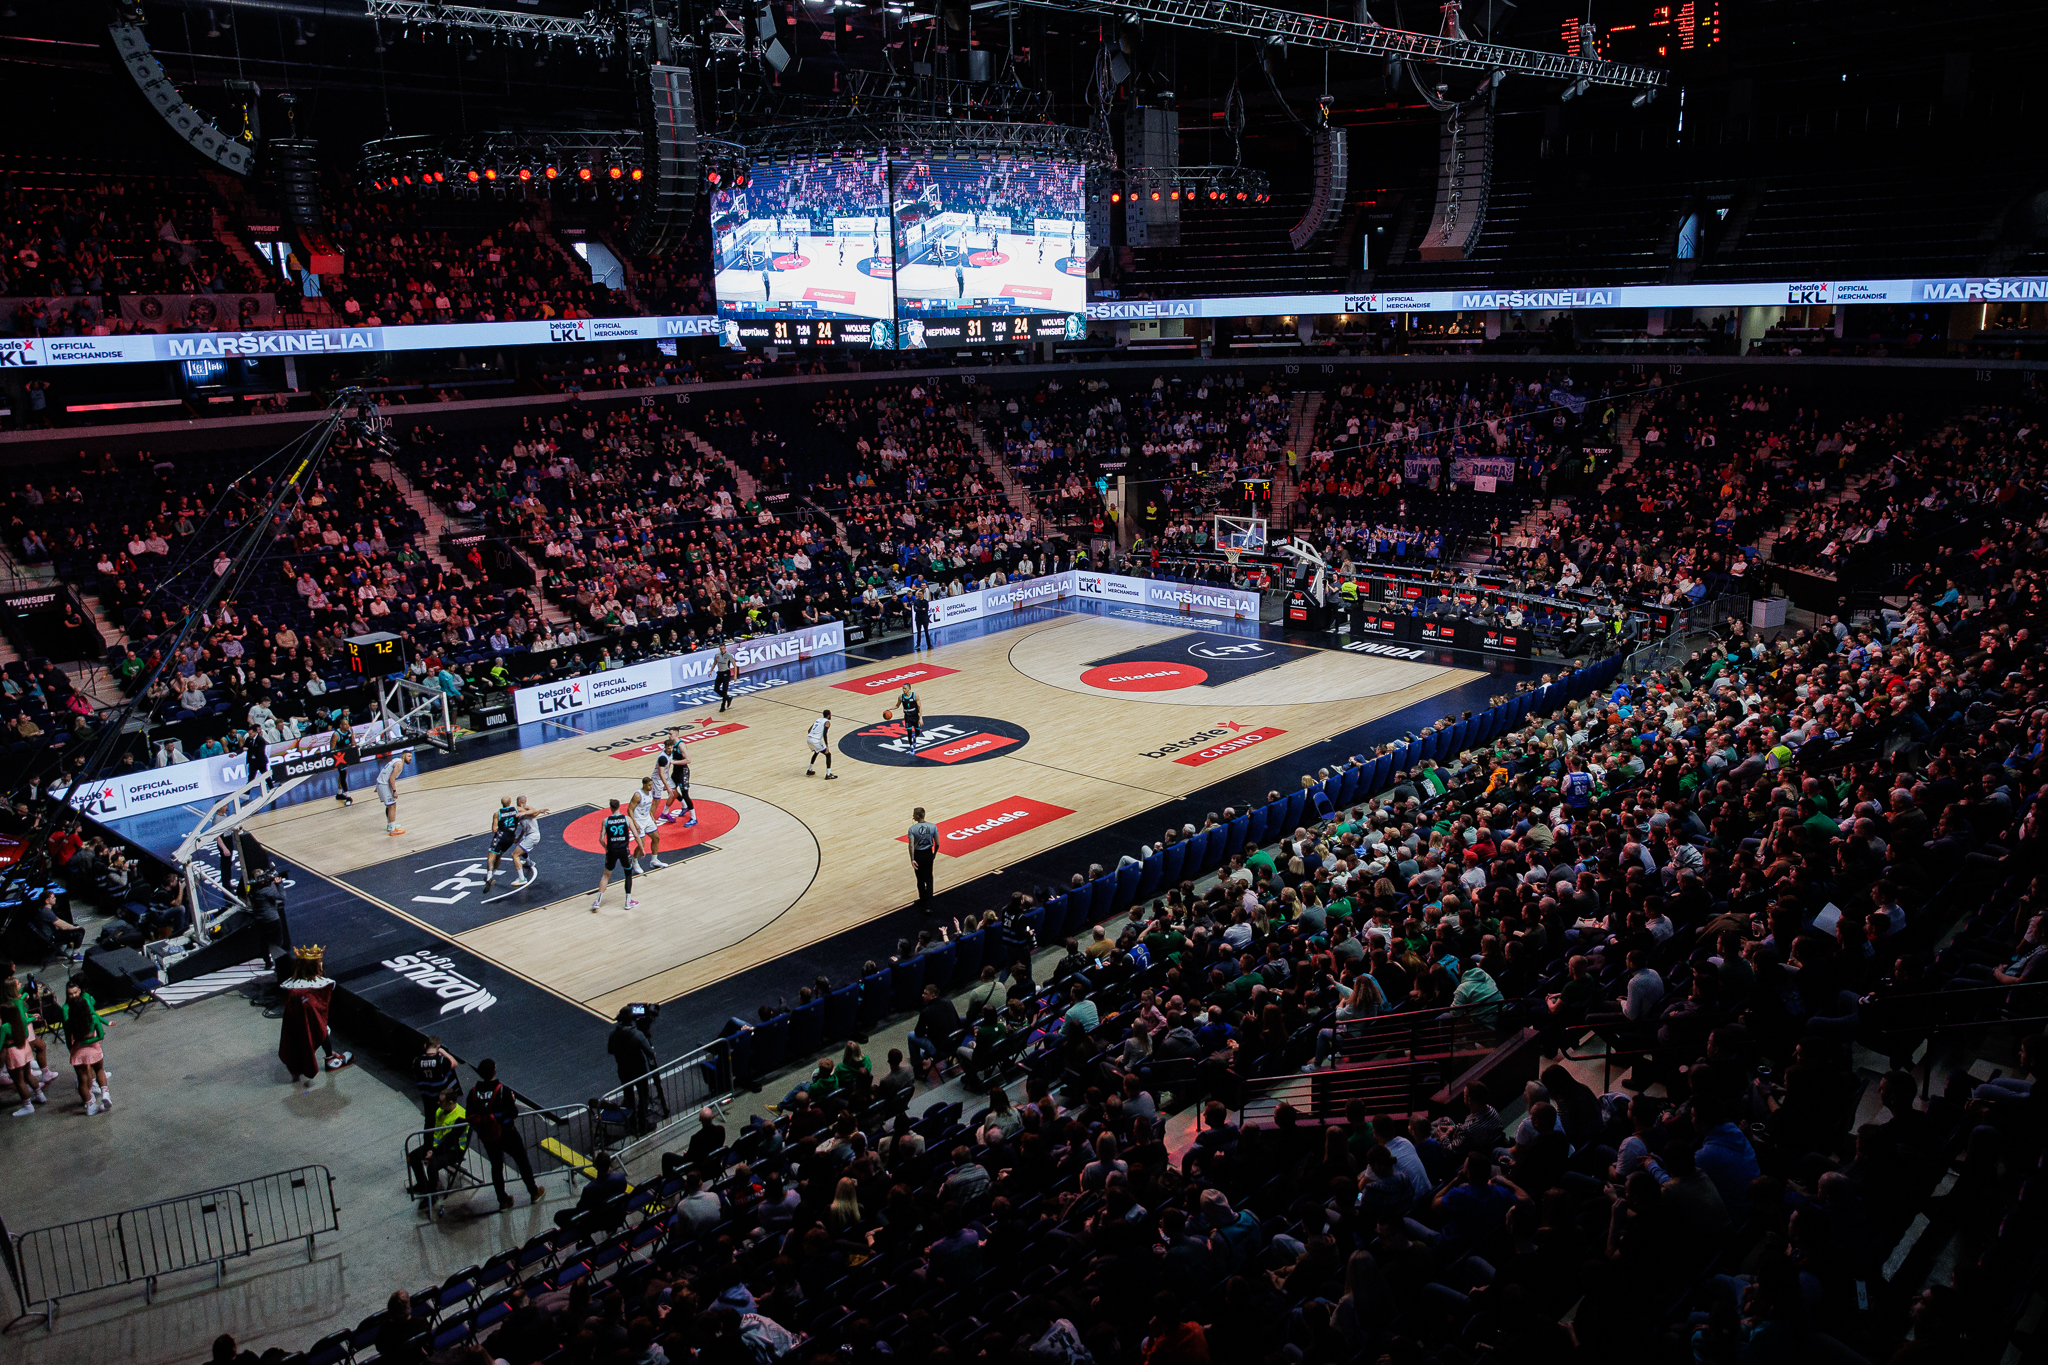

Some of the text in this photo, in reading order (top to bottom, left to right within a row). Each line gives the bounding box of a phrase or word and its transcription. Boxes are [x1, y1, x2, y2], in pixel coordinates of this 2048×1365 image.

[1653, 6, 1669, 18] 24
[1658, 46, 1666, 55] 4
[1788, 283, 1820, 293] betsafe
[1344, 295, 1371, 303] betsafe
[1462, 289, 1612, 309] MARŠKINĖLIAI
[1787, 291, 1828, 304] LKL
[1837, 292, 1887, 300] MERCHANDISE
[1086, 300, 1195, 319] RŠKINĖLIAI
[1344, 301, 1377, 313] LKL
[1386, 302, 1431, 310] MERCHANDISE
[550, 320, 577, 330] betsafe
[593, 322, 622, 330] OFFICIAL
[844, 324, 871, 333] WOLVES
[967, 319, 982, 337] 31
[991, 321, 1007, 333] 7:24
[1014, 317, 1028, 334] 24
[1041, 318, 1065, 327] WOLVES
[550, 329, 586, 342] LKL
[594, 329, 639, 338] MERCHANDISE
[774, 321, 788, 339] 31
[817, 321, 832, 339] 24
[926, 326, 961, 337] NEPTŪNAS
[1036, 327, 1065, 337] TWINSBET
[169, 329, 375, 358] MARŠKINĖLIAI
[840, 334, 871, 343] TWINSBET
[0, 340, 22, 351] safe
[50, 341, 96, 351] OFFICIAL
[0, 350, 38, 366] KL
[52, 350, 124, 360] MERCHANDISE
[1284, 364, 1300, 374] 109
[1321, 364, 1334, 374] 110
[1631, 363, 1644, 375] 111
[1668, 364, 1683, 375] 112
[926, 376, 940, 387] 107
[960, 375, 976, 385] 108
[1975, 369, 1992, 382] 113
[640, 395, 656, 407] 105
[675, 393, 691, 404] 106
[1078, 576, 1097, 584] betsafe
[1107, 581, 1128, 589] OFFICIAL
[987, 579, 1073, 608] MARŠKINĖLIAI
[1078, 583, 1102, 594] LKL
[1107, 588, 1140, 597] MERCHANDISE
[5, 593, 56, 607] TWINSBET
[1151, 588, 1255, 613] MARŠKINĖLIAI
[946, 602, 966, 611] OFFICIAL
[946, 606, 978, 618] MERCHANDISE
[1364, 622, 1378, 630] KMT
[1422, 629, 1436, 637] KMT
[375, 641, 393, 654] 7.2
[1484, 637, 1498, 646] KMT
[682, 631, 838, 680] MAŠKINĖLIAI
[1200, 643, 1264, 657] LRT
[1342, 640, 1426, 660] UNIQA
[865, 668, 928, 688] Citadele
[1107, 670, 1181, 684] Citadele
[592, 677, 627, 690] OFFICIAL
[538, 686, 572, 700] betsafe
[593, 681, 648, 699] MERCHANDISE
[539, 694, 583, 715] LKL
[485, 713, 508, 726] UNIQA
[641, 730, 720, 753] CAINO
[878, 723, 966, 753] KMT
[1138, 729, 1228, 759] betsafe
[943, 738, 992, 756] Citadele
[1200, 734, 1263, 758] CASINO
[286, 756, 335, 776] betsafe
[129, 779, 173, 794] OFFICIAL
[131, 782, 200, 803] MERCHANDISE
[69, 792, 103, 806] etsafe
[80, 800, 117, 816] KL
[610, 824, 625, 836] 98
[946, 810, 1030, 841] Citadele
[411, 863, 507, 905] LRT
[415, 950, 456, 970] agro
[420, 1060, 437, 1068] FOTO
[423, 1069, 434, 1079] 13
